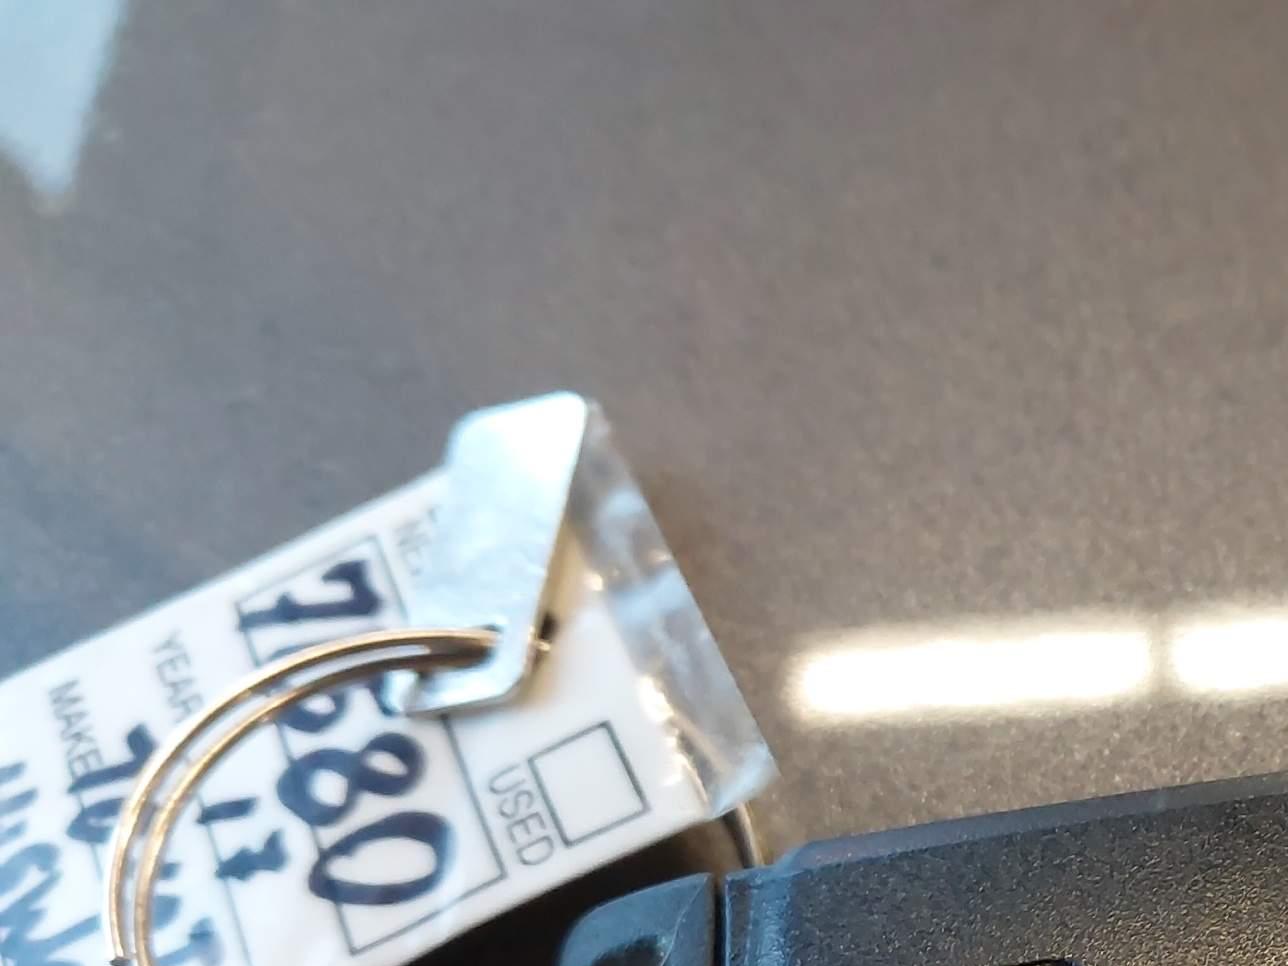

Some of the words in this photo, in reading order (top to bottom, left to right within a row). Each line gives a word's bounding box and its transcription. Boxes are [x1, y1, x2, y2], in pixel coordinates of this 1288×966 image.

[150, 629, 202, 725] YEAR
[47, 679, 101, 785] MAKE
[487, 764, 556, 868] USED
